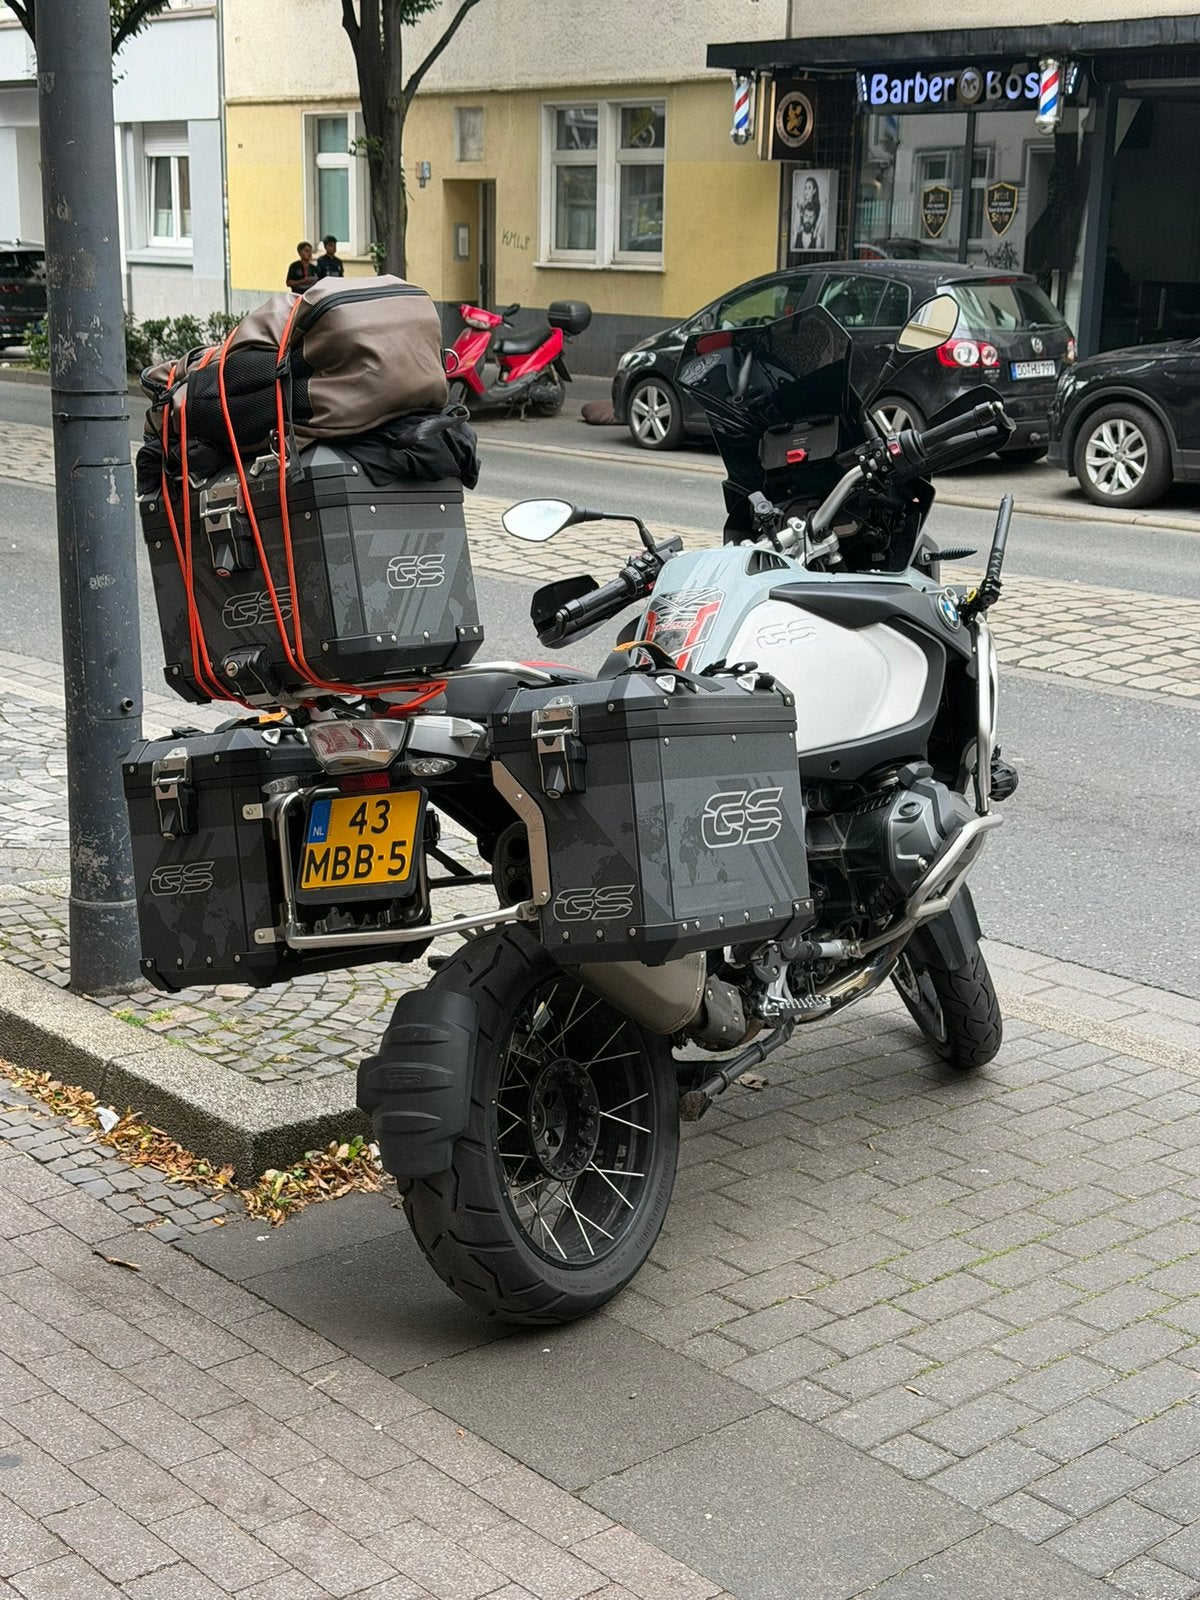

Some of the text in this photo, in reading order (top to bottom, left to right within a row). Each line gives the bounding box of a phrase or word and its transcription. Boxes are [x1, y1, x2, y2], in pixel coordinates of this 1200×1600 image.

[870, 70, 1041, 105] Barber Bos
[386, 554, 446, 590] GS
[221, 586, 296, 630] GS
[312, 825, 325, 837] NL
[348, 799, 392, 836] 43
[700, 786, 784, 850] GS
[150, 861, 216, 897] GS
[304, 840, 407, 884] MBB-5
[553, 884, 636, 923] GS
